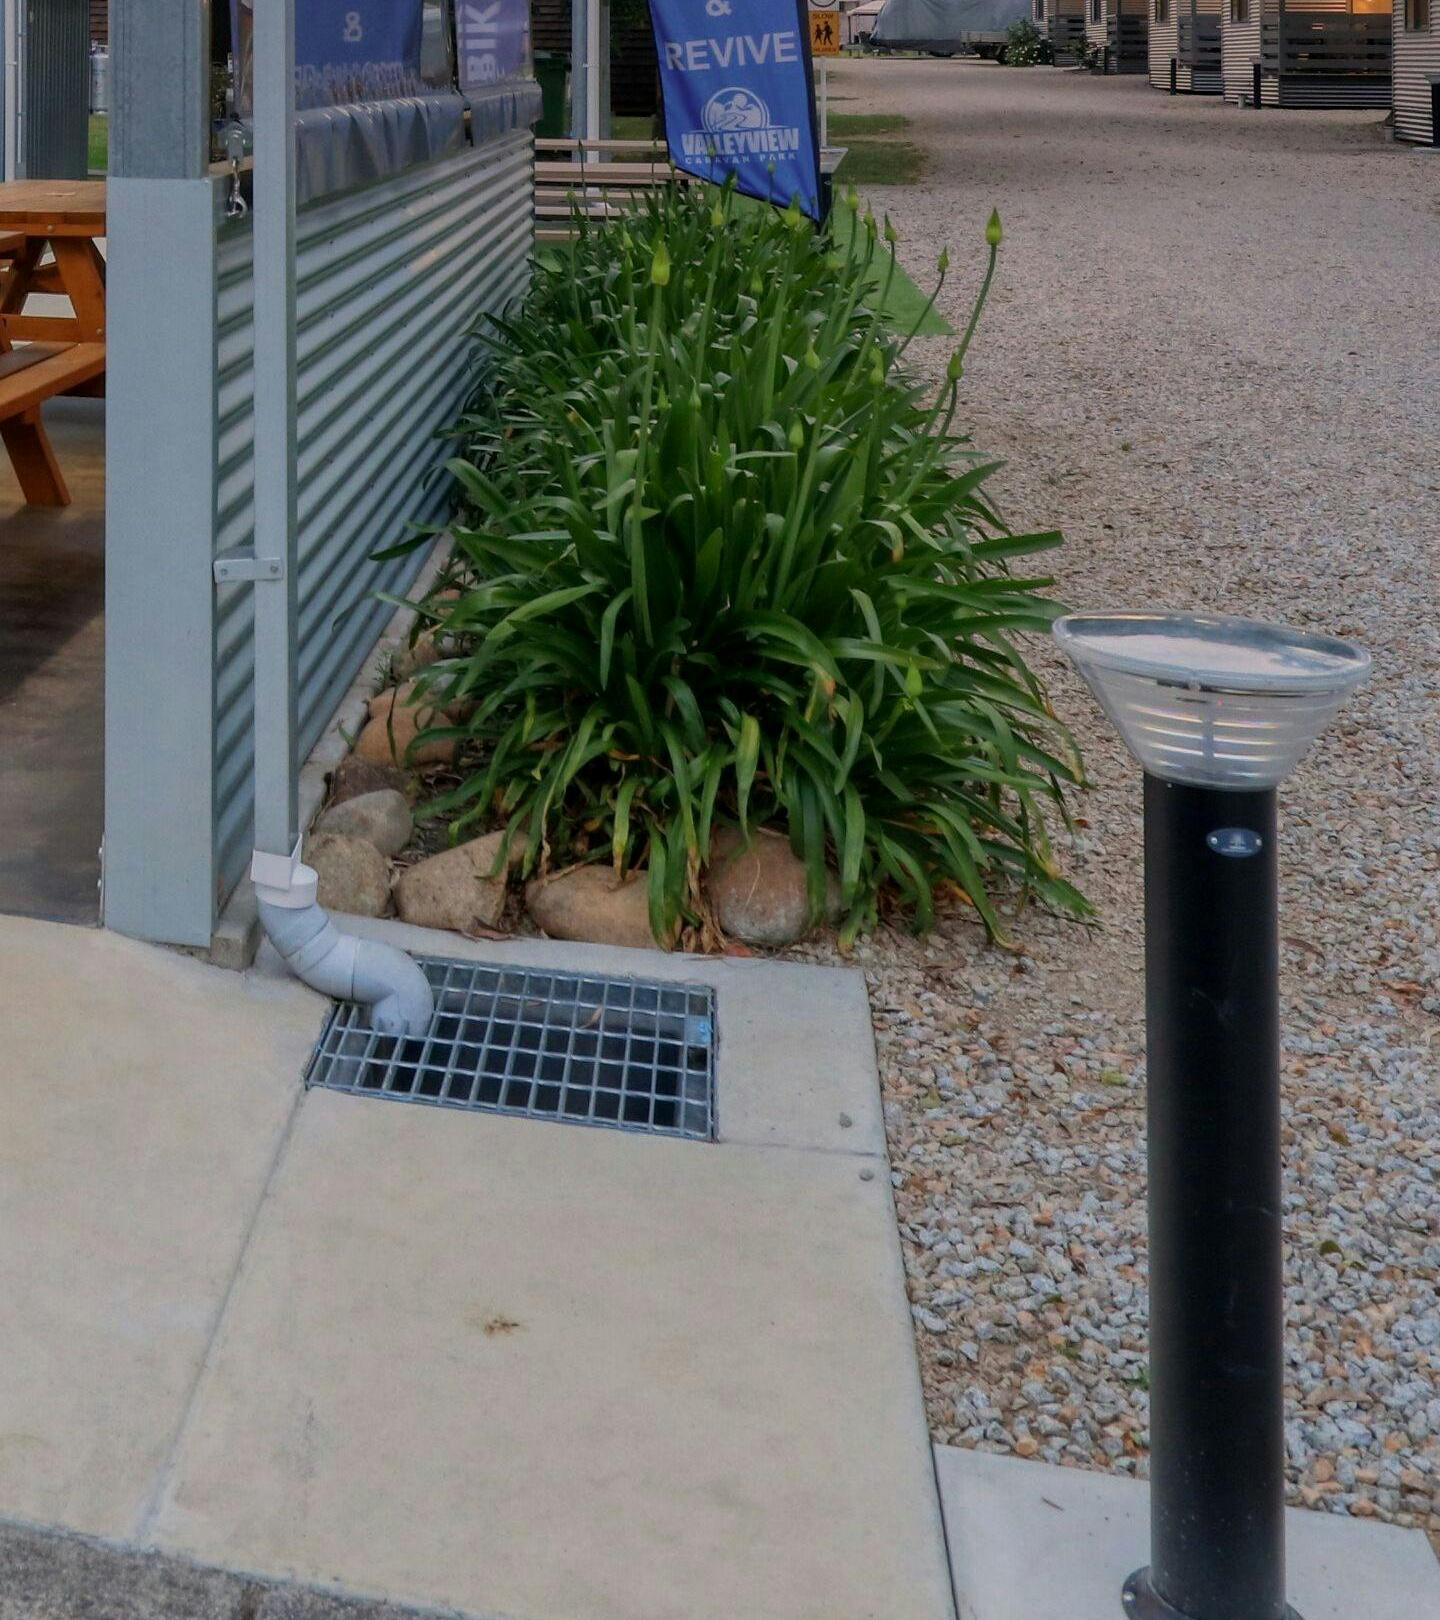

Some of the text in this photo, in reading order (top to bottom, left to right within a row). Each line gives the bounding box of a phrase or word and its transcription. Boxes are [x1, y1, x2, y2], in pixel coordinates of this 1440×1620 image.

[664, 31, 799, 71] REVIVE
[681, 128, 799, 156] VALLEYVIEW
[760, 152, 796, 161] PARK
